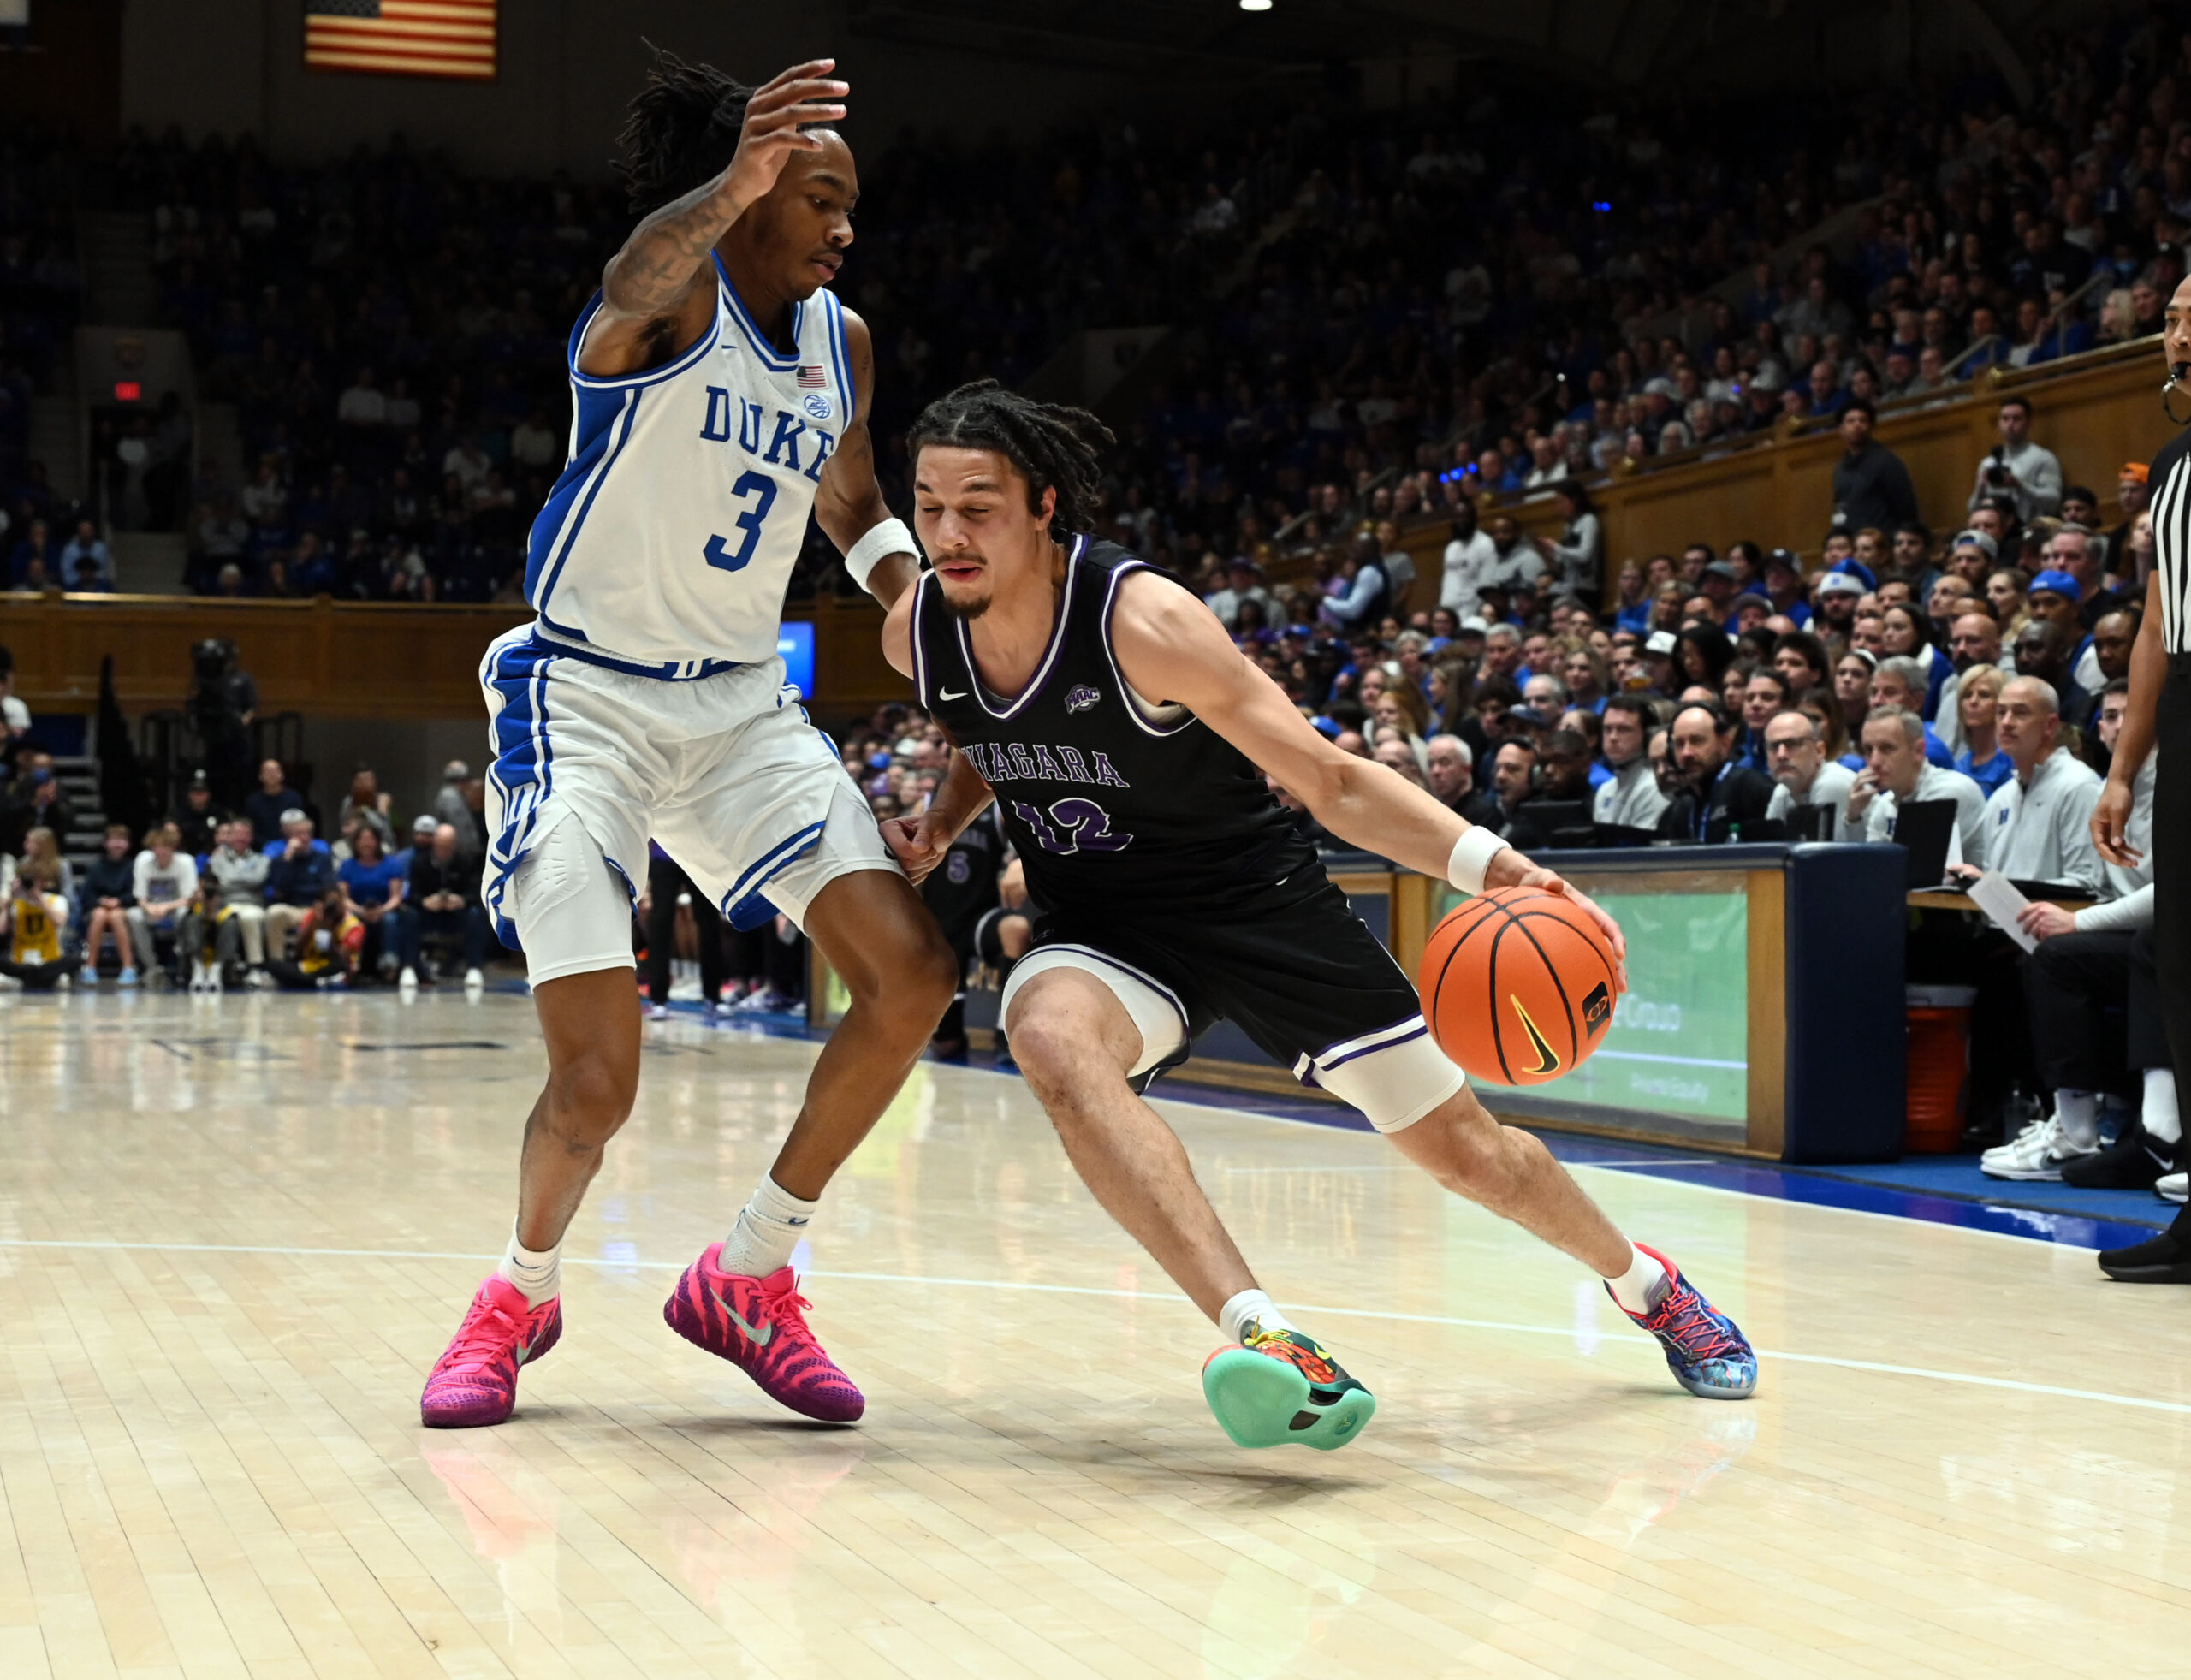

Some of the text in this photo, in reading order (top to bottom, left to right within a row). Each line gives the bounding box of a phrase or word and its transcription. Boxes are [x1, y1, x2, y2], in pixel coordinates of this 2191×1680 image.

[699, 385, 834, 484] DUKE
[703, 470, 778, 573] 3
[1011, 797, 1134, 855] 12
[947, 850, 970, 884] 5
